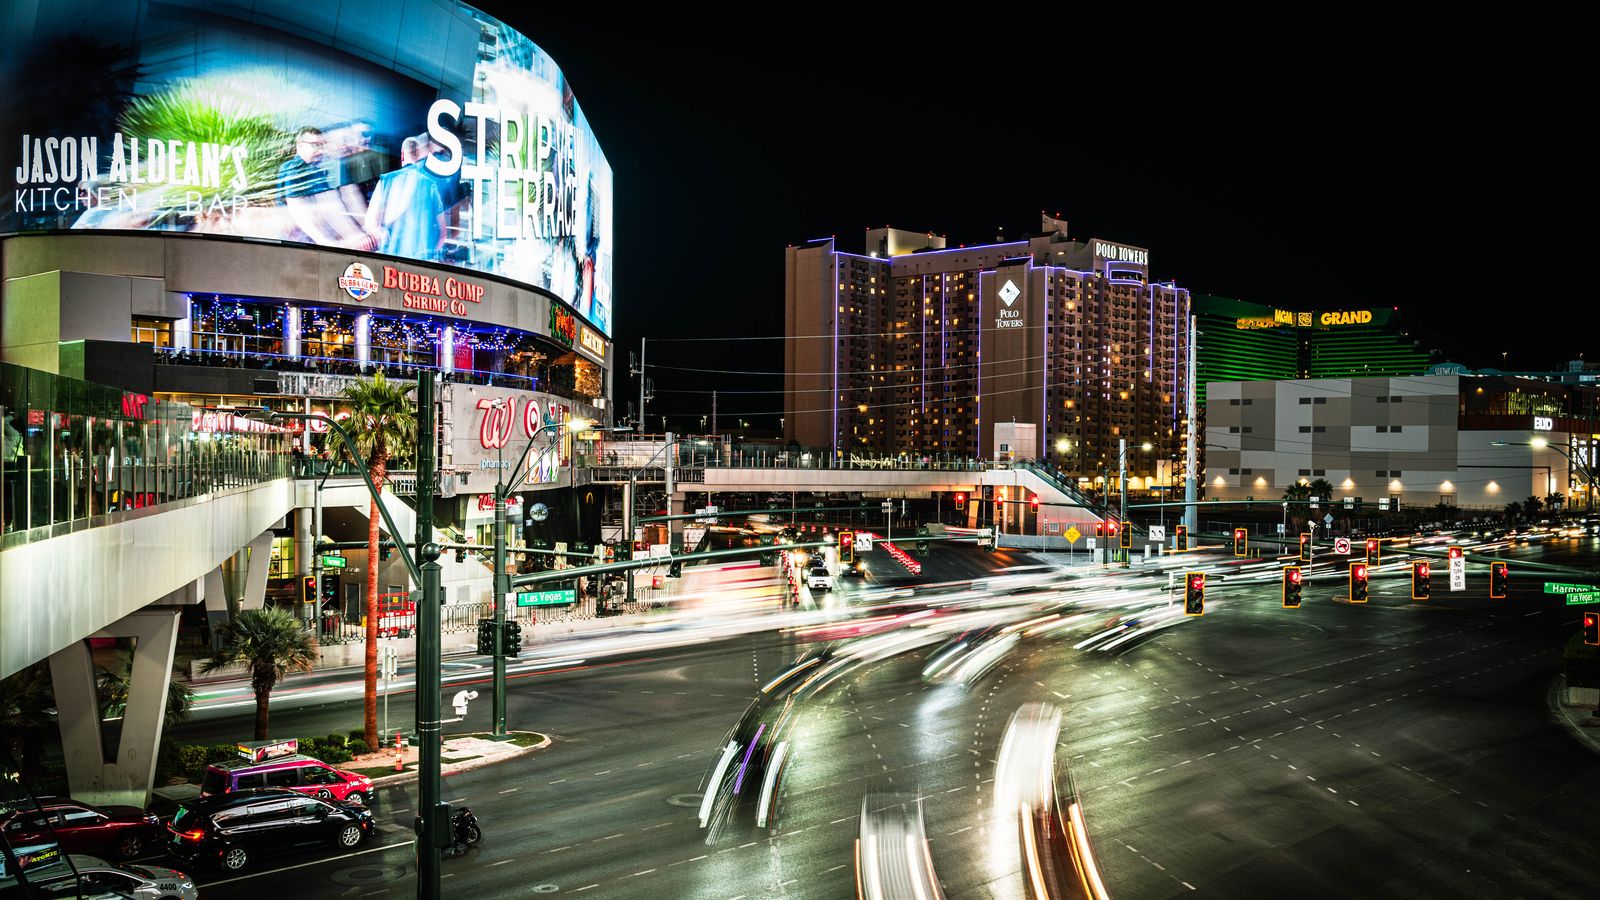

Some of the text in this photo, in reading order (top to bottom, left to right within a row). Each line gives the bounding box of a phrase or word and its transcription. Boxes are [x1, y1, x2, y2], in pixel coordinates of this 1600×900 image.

[425, 98, 552, 177] STRIP
[16, 132, 249, 191] JASON ALDEAN'S
[15, 187, 138, 213] KITCHEN
[186, 191, 249, 225] BAR
[461, 165, 578, 240] TERRACE
[1096, 242, 1148, 265] POLO TOWERS
[383, 265, 484, 303] BUBBA GUMP
[403, 292, 448, 312] SHRIMP
[1000, 309, 1019, 318] POLO
[1274, 309, 1293, 325] MGM
[1320, 310, 1372, 325] GRAND
[995, 319, 1024, 329] TOWERS
[525, 593, 539, 603] Las
[540, 591, 563, 604] Vegas
[1570, 594, 1579, 602] Las
[1579, 593, 1593, 604] Vegas
[160, 882, 177, 891] 4400
